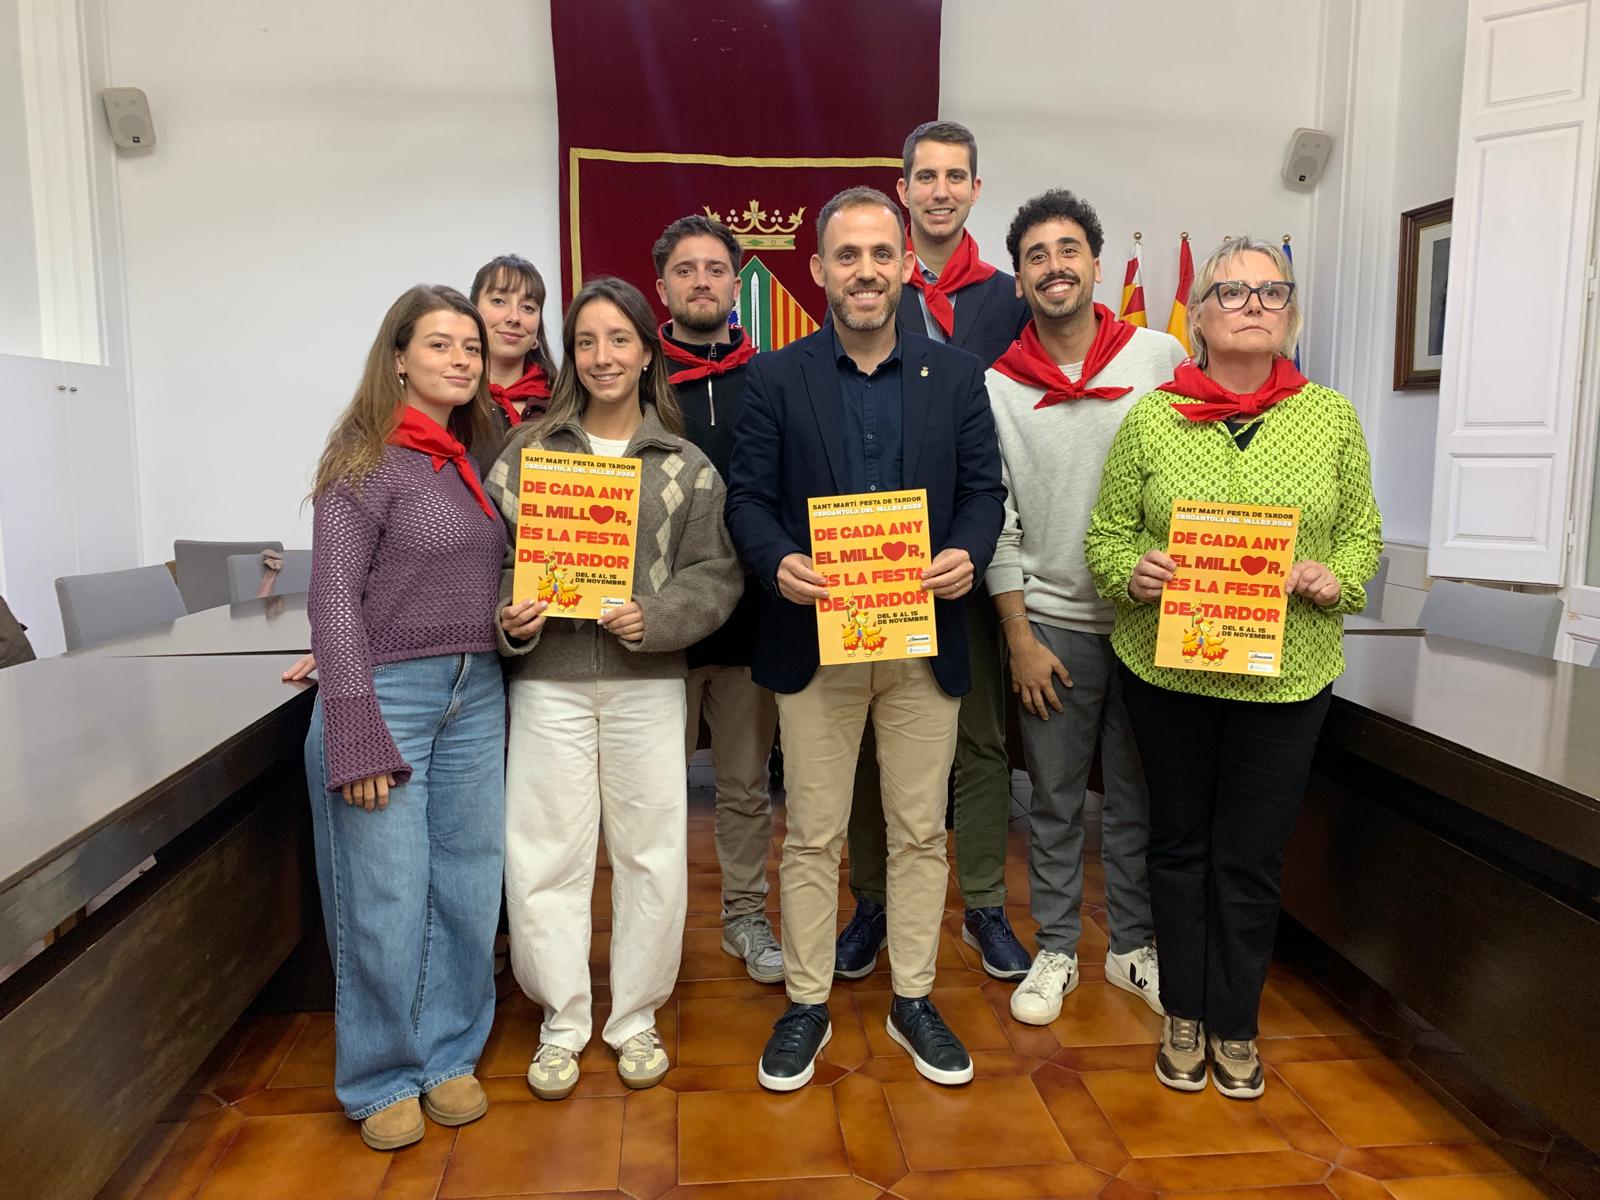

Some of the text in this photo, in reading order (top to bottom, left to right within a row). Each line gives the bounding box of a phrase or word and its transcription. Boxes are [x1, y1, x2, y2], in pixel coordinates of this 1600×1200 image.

[523, 480, 634, 500] DE CADA ANY
[521, 503, 542, 517] EL
[520, 523, 630, 546] ÉS LA FESTA
[814, 520, 923, 541] DE CADA ANY
[1172, 531, 1290, 551] DE CADA ANY
[518, 549, 630, 569] DE TARDOR
[816, 552, 838, 565] EL
[844, 572, 868, 586] LA
[1166, 574, 1281, 598] ÉS LA FESTA
[819, 590, 928, 612] DE TARDOR
[1164, 601, 1280, 623] DE TARDOR
[1234, 632, 1276, 640] NOVEMBRE
